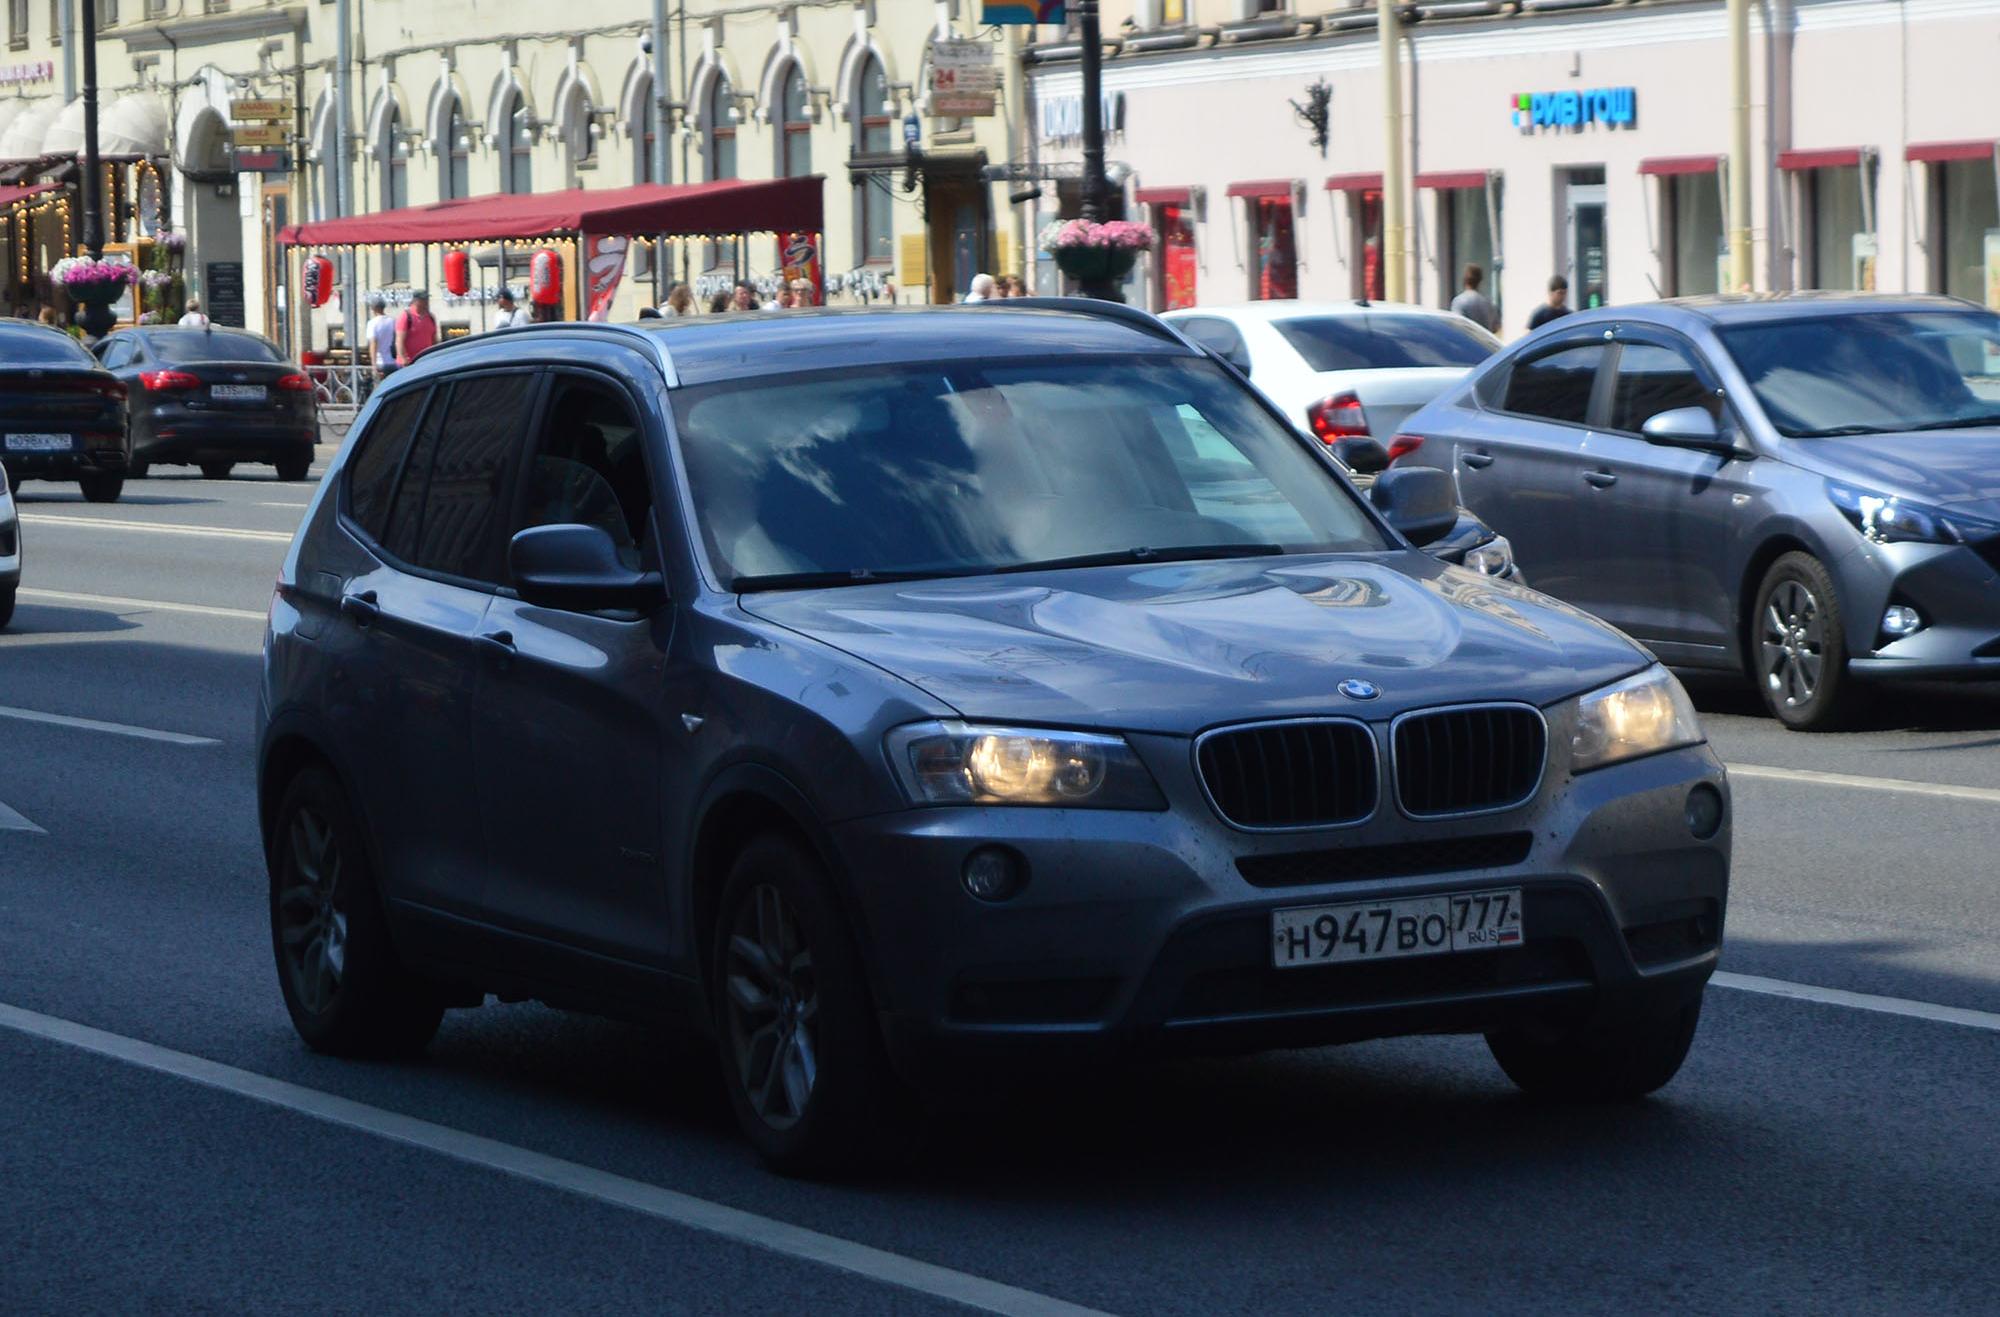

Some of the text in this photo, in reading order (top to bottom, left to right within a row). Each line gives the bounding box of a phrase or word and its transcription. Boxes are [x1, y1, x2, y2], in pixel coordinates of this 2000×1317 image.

[936, 69, 955, 84] 24
[1582, 87, 1633, 121] ГОШ
[1288, 895, 1511, 960] Н947ВО 777
[1468, 931, 1497, 944] RUS
